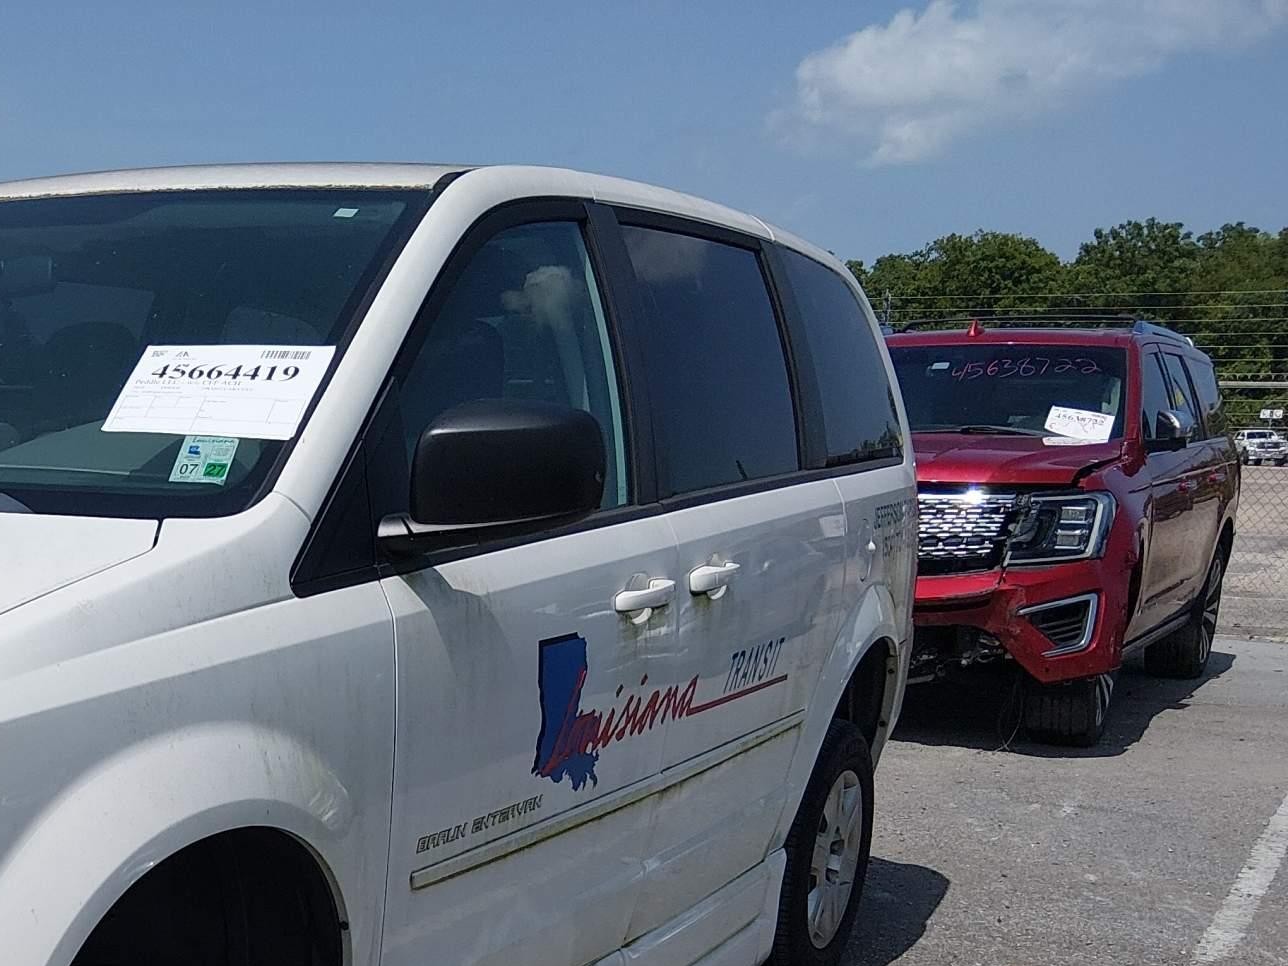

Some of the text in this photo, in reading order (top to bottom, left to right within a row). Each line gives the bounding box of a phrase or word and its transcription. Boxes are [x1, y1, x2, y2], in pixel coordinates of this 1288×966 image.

[151, 363, 300, 382] 45664419
[951, 357, 1103, 381] 45638722
[179, 463, 199, 475] 07
[208, 464, 226, 476] 27
[723, 637, 786, 694] TRANSIT
[416, 794, 544, 854] BRAUN ENTERVAN
